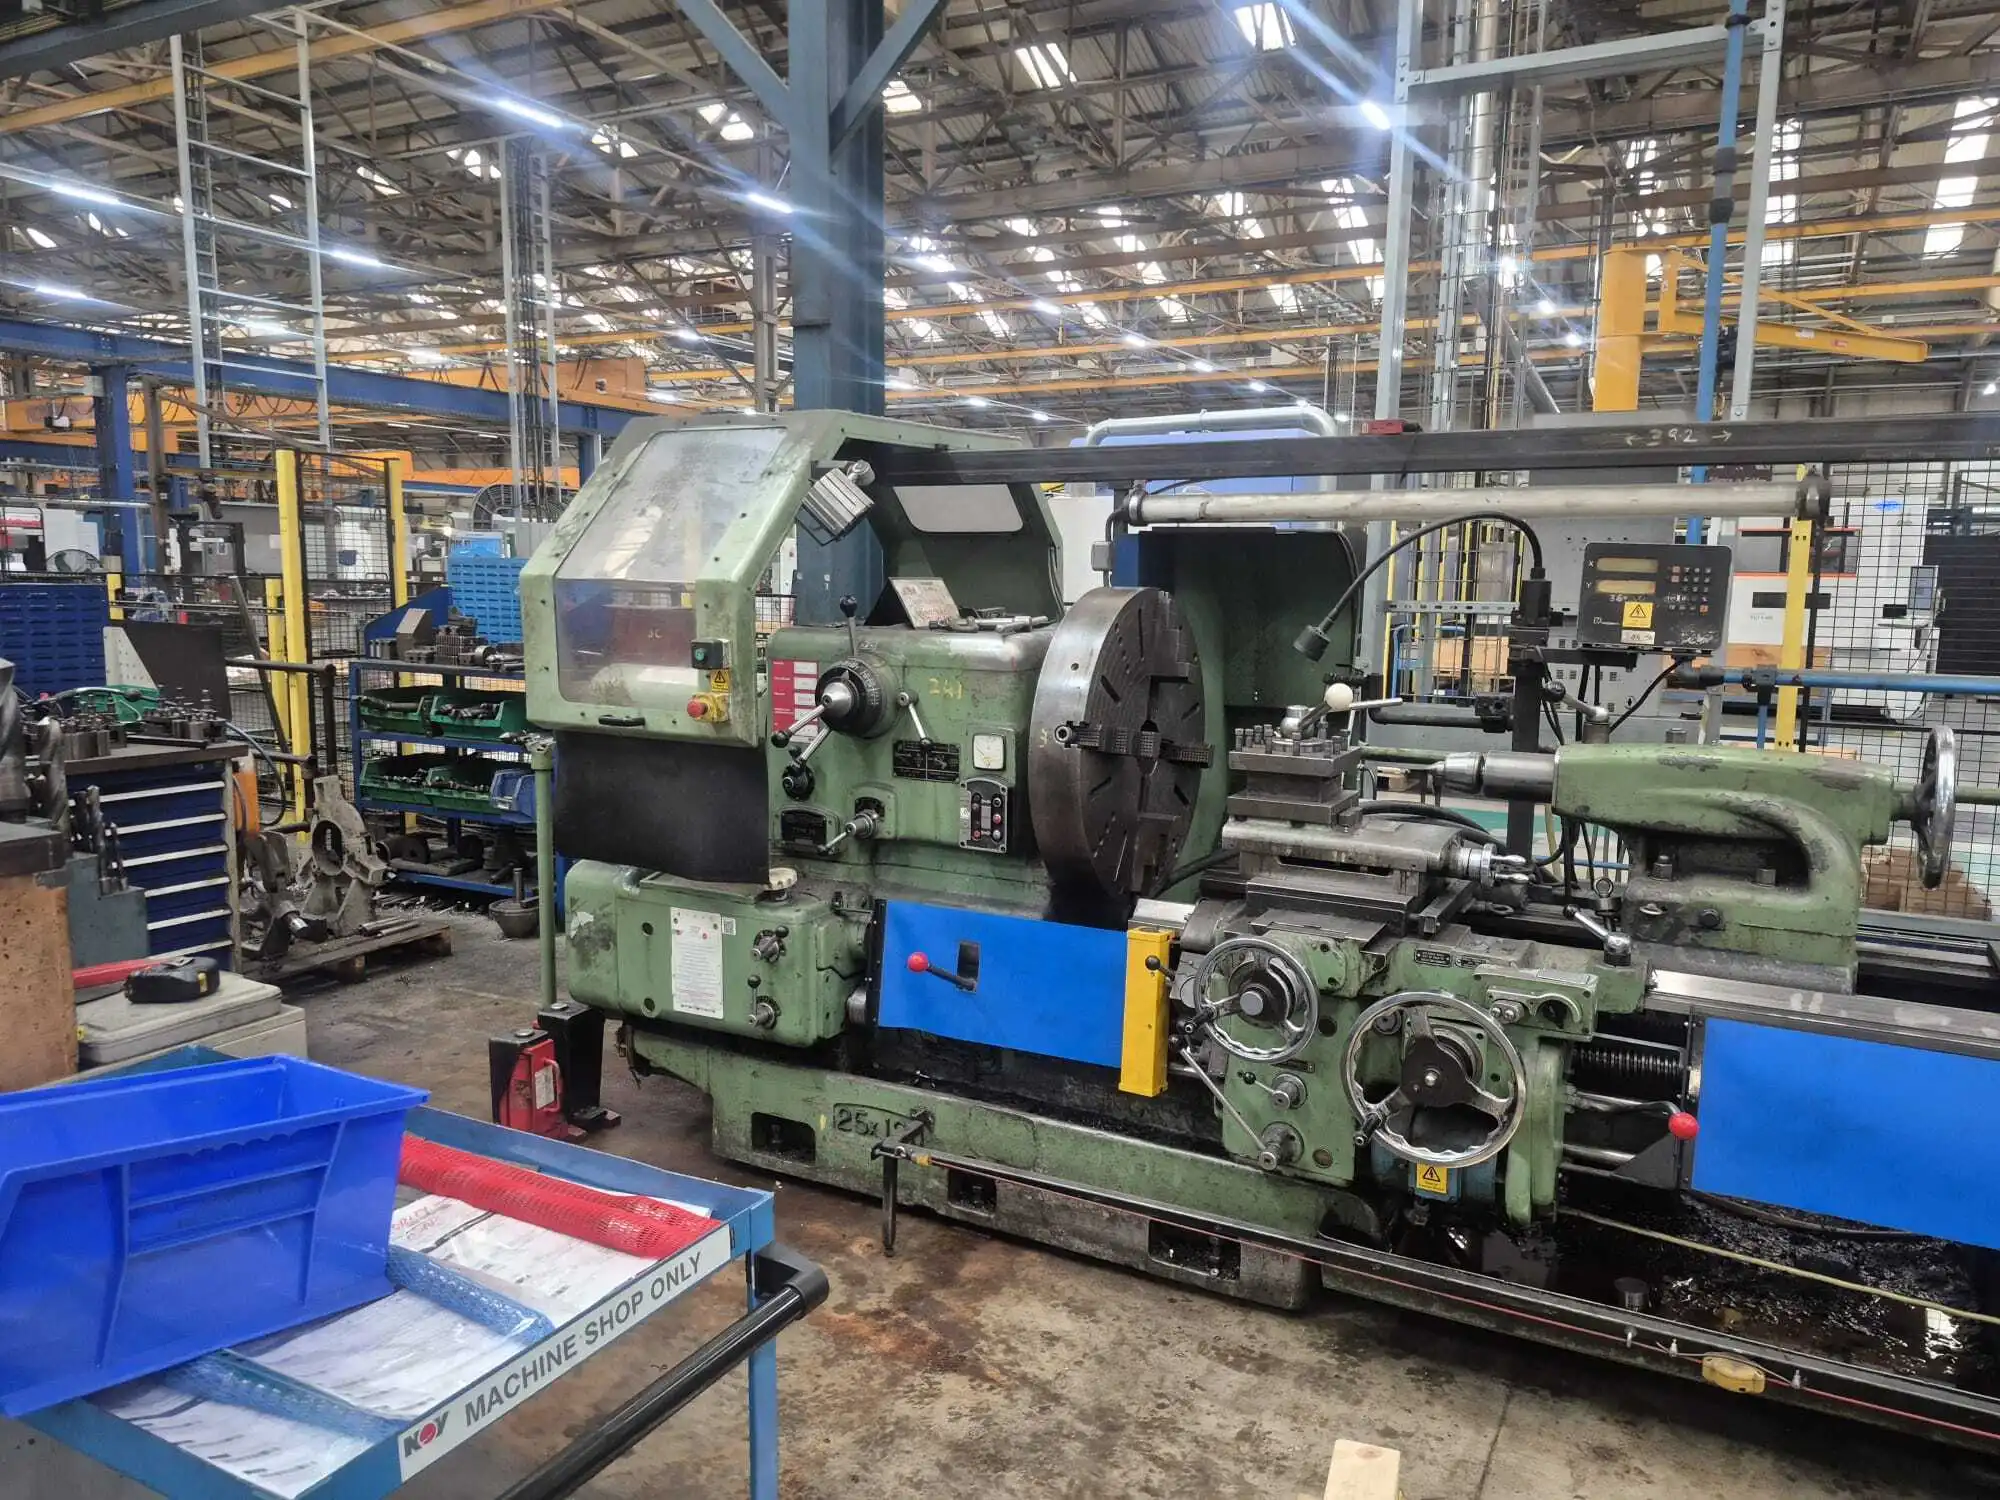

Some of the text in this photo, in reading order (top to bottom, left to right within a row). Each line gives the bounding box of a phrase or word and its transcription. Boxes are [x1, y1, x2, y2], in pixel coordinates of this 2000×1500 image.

[464, 1333, 579, 1427] MACHINE
[583, 1290, 644, 1345] SHOP
[650, 1252, 702, 1300] ONLY
